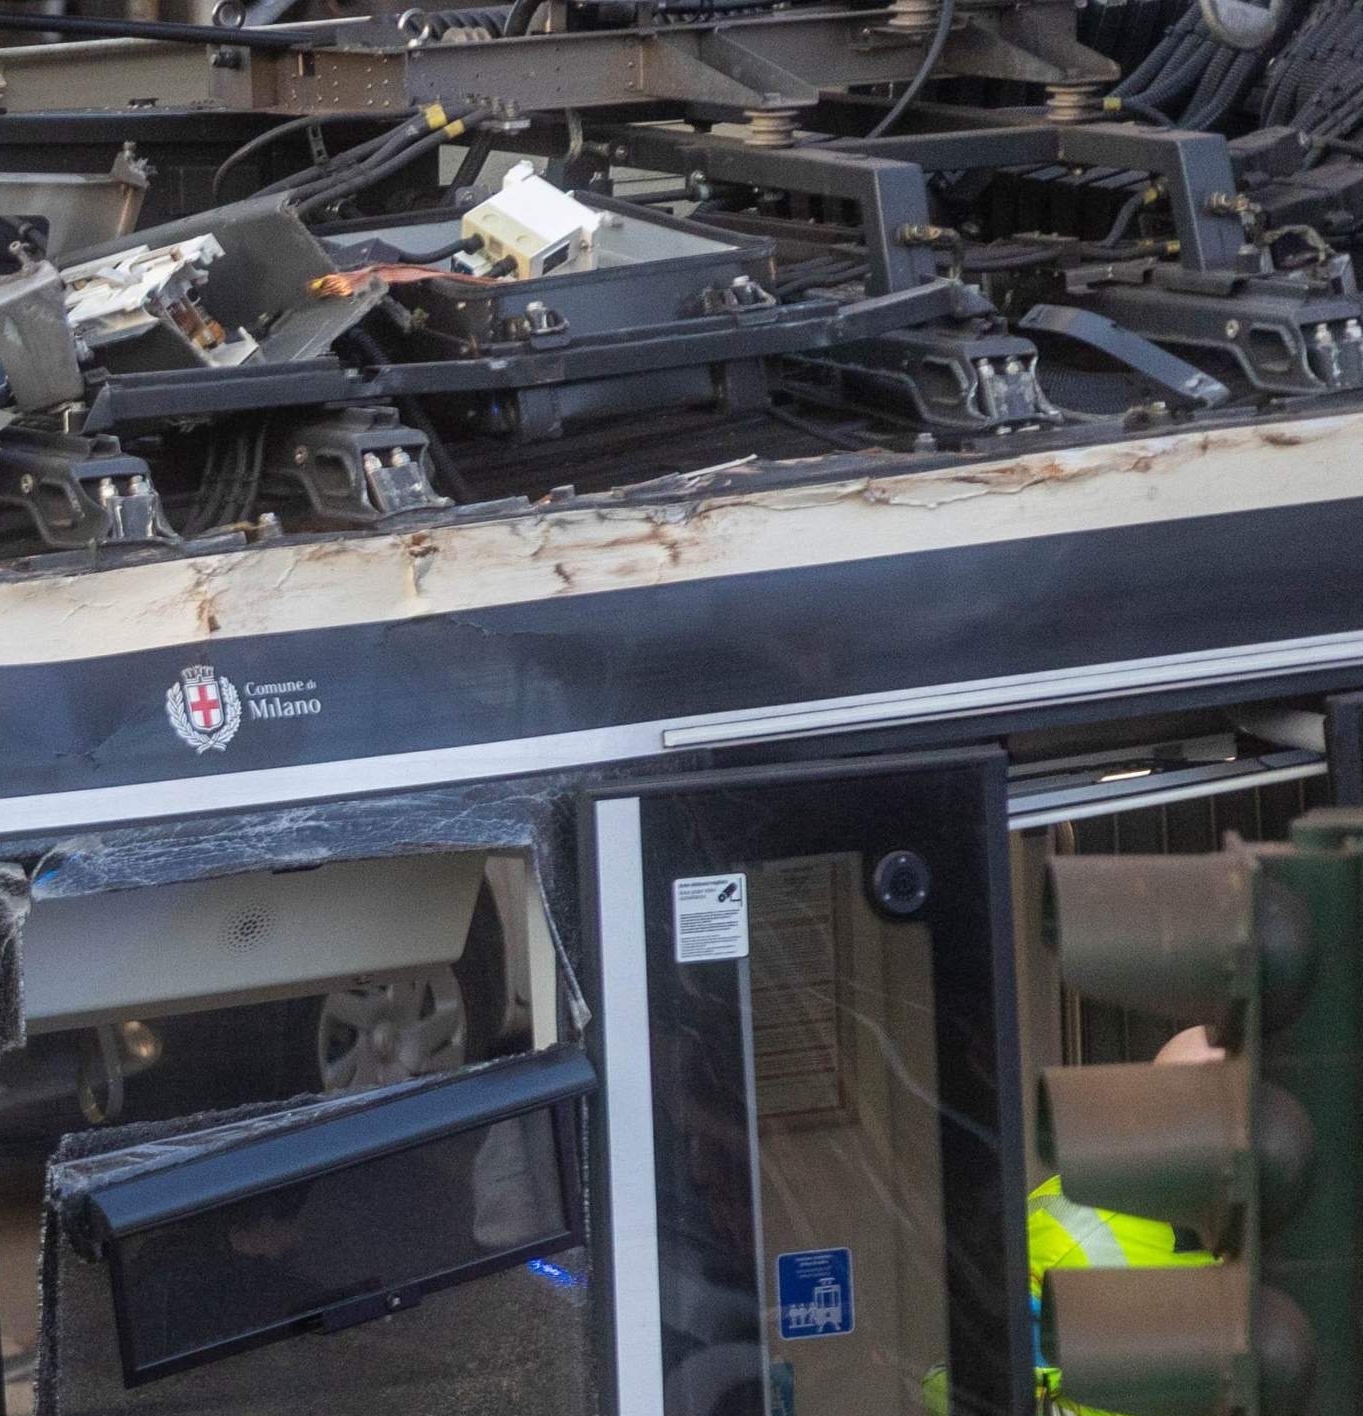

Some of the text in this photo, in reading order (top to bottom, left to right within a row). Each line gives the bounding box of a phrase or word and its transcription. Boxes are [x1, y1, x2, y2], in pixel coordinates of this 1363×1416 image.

[245, 679, 317, 697] Comune di
[248, 697, 323, 720] Milano
